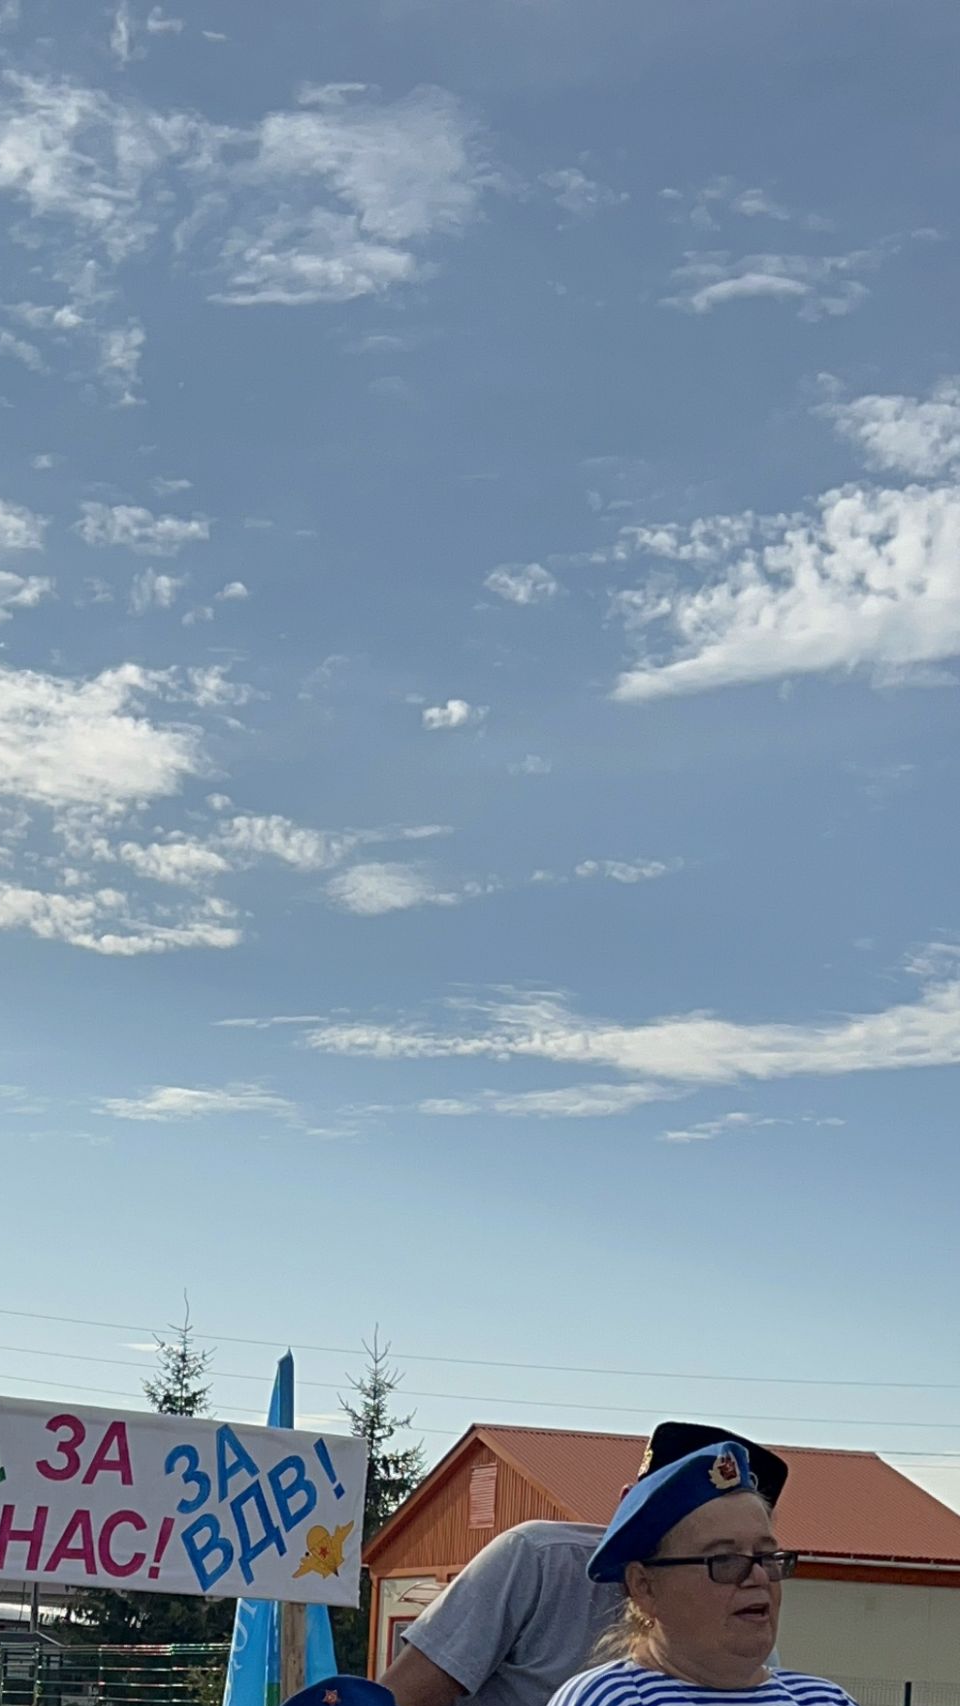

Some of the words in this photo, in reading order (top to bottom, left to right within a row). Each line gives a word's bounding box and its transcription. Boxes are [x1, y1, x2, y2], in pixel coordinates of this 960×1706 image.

[35, 1413, 134, 1486] ЗА
[163, 1423, 261, 1515] ЗА
[179, 1437, 346, 1593] ВДВ!
